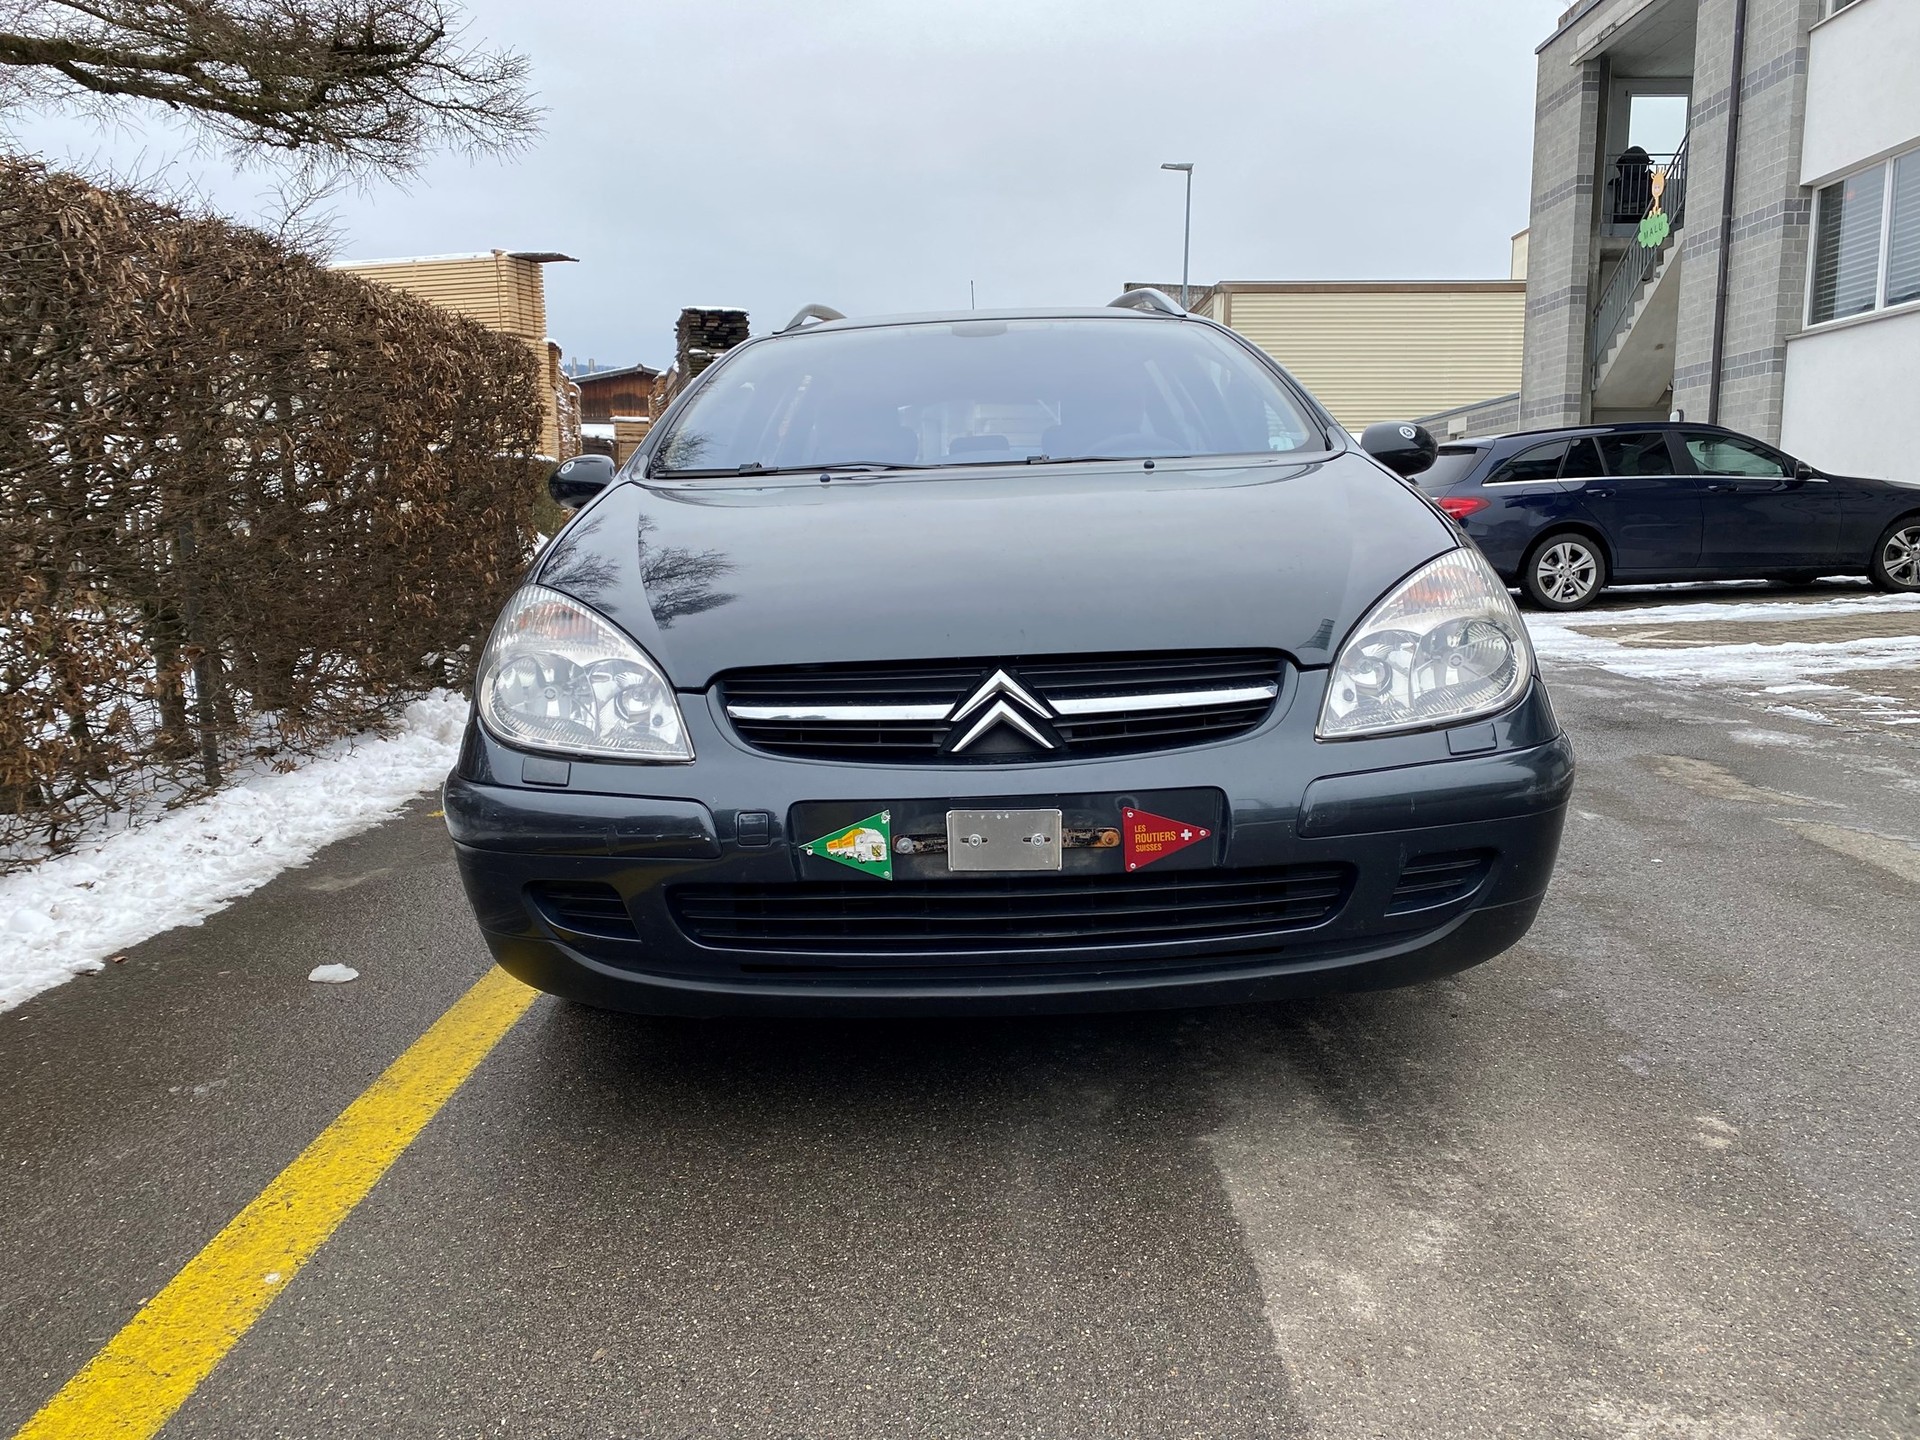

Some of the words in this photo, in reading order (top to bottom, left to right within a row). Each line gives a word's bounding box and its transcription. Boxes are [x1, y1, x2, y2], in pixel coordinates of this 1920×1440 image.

[1643, 222, 1663, 239] MALU
[1134, 824, 1146, 833] LES
[1135, 831, 1176, 843] ROUTIERS
[1135, 843, 1162, 852] SUISSES
